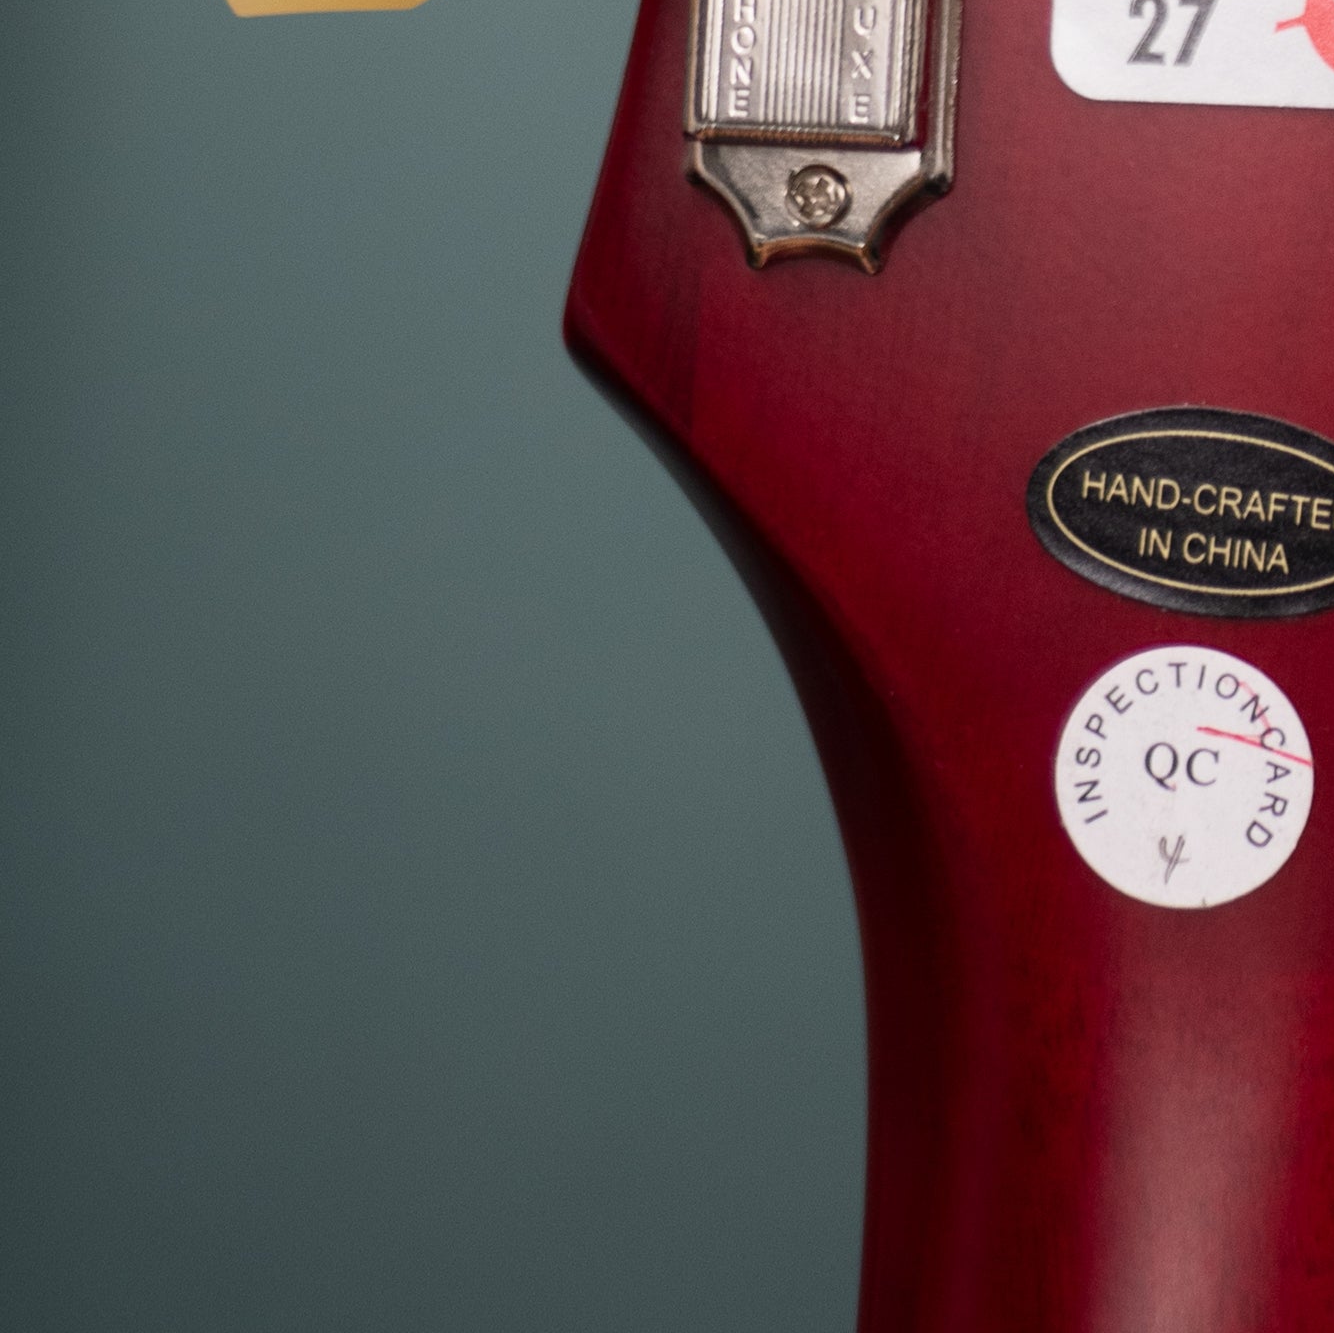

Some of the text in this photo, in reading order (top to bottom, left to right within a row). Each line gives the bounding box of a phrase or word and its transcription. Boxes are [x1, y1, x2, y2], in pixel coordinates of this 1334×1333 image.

[1138, 528, 1290, 575] IN CHINA
[1073, 662, 1293, 849] INSPECTION CARD
[1144, 742, 1220, 791] QC
